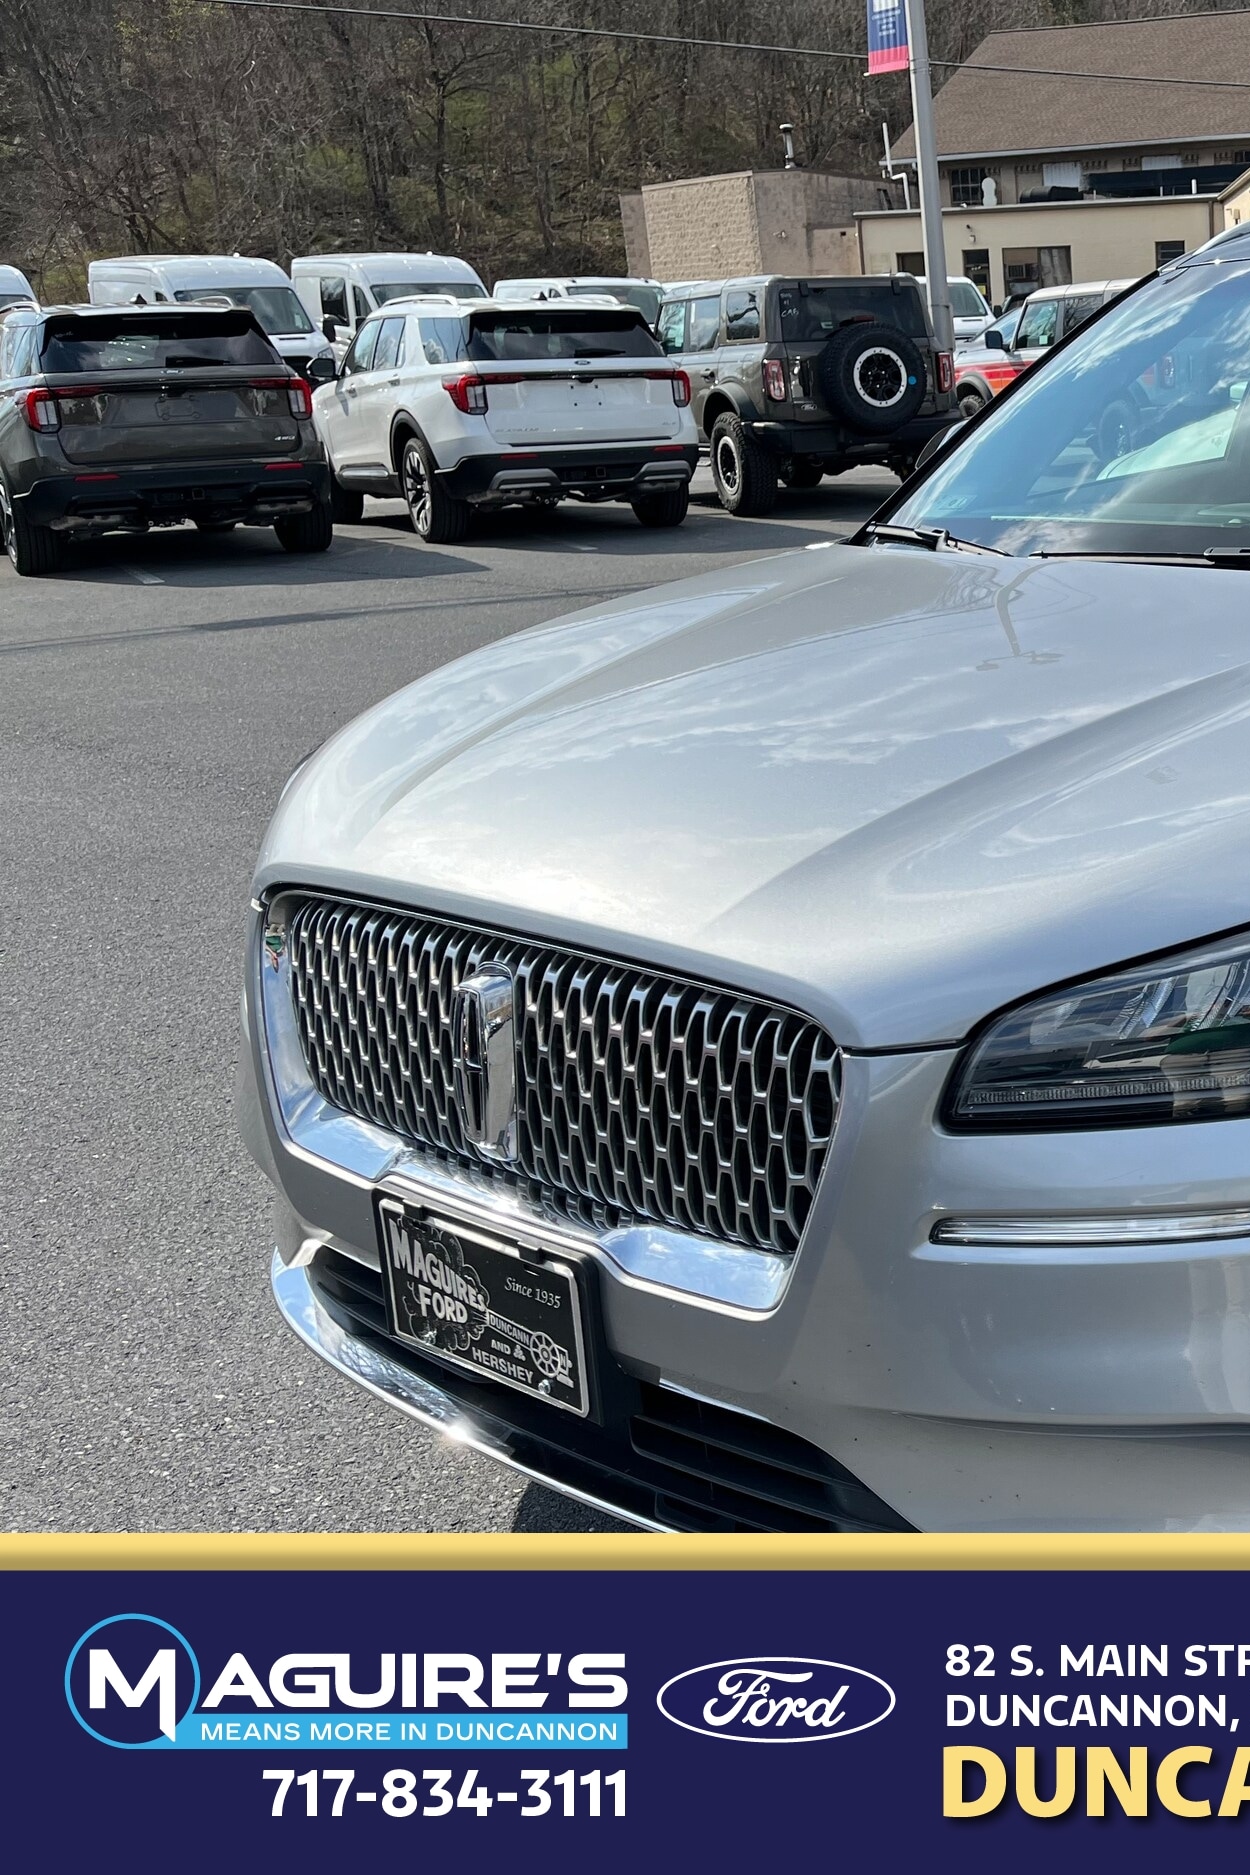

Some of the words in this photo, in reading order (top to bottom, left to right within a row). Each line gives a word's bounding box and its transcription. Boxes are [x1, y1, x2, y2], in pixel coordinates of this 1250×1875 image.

[389, 1218, 486, 1312] MAGUIRES
[418, 1284, 468, 1323] FORD
[504, 1277, 533, 1298] Since
[535, 1288, 561, 1309] 1935
[472, 1346, 534, 1384] HERSHEY
[491, 1339, 511, 1355] AND
